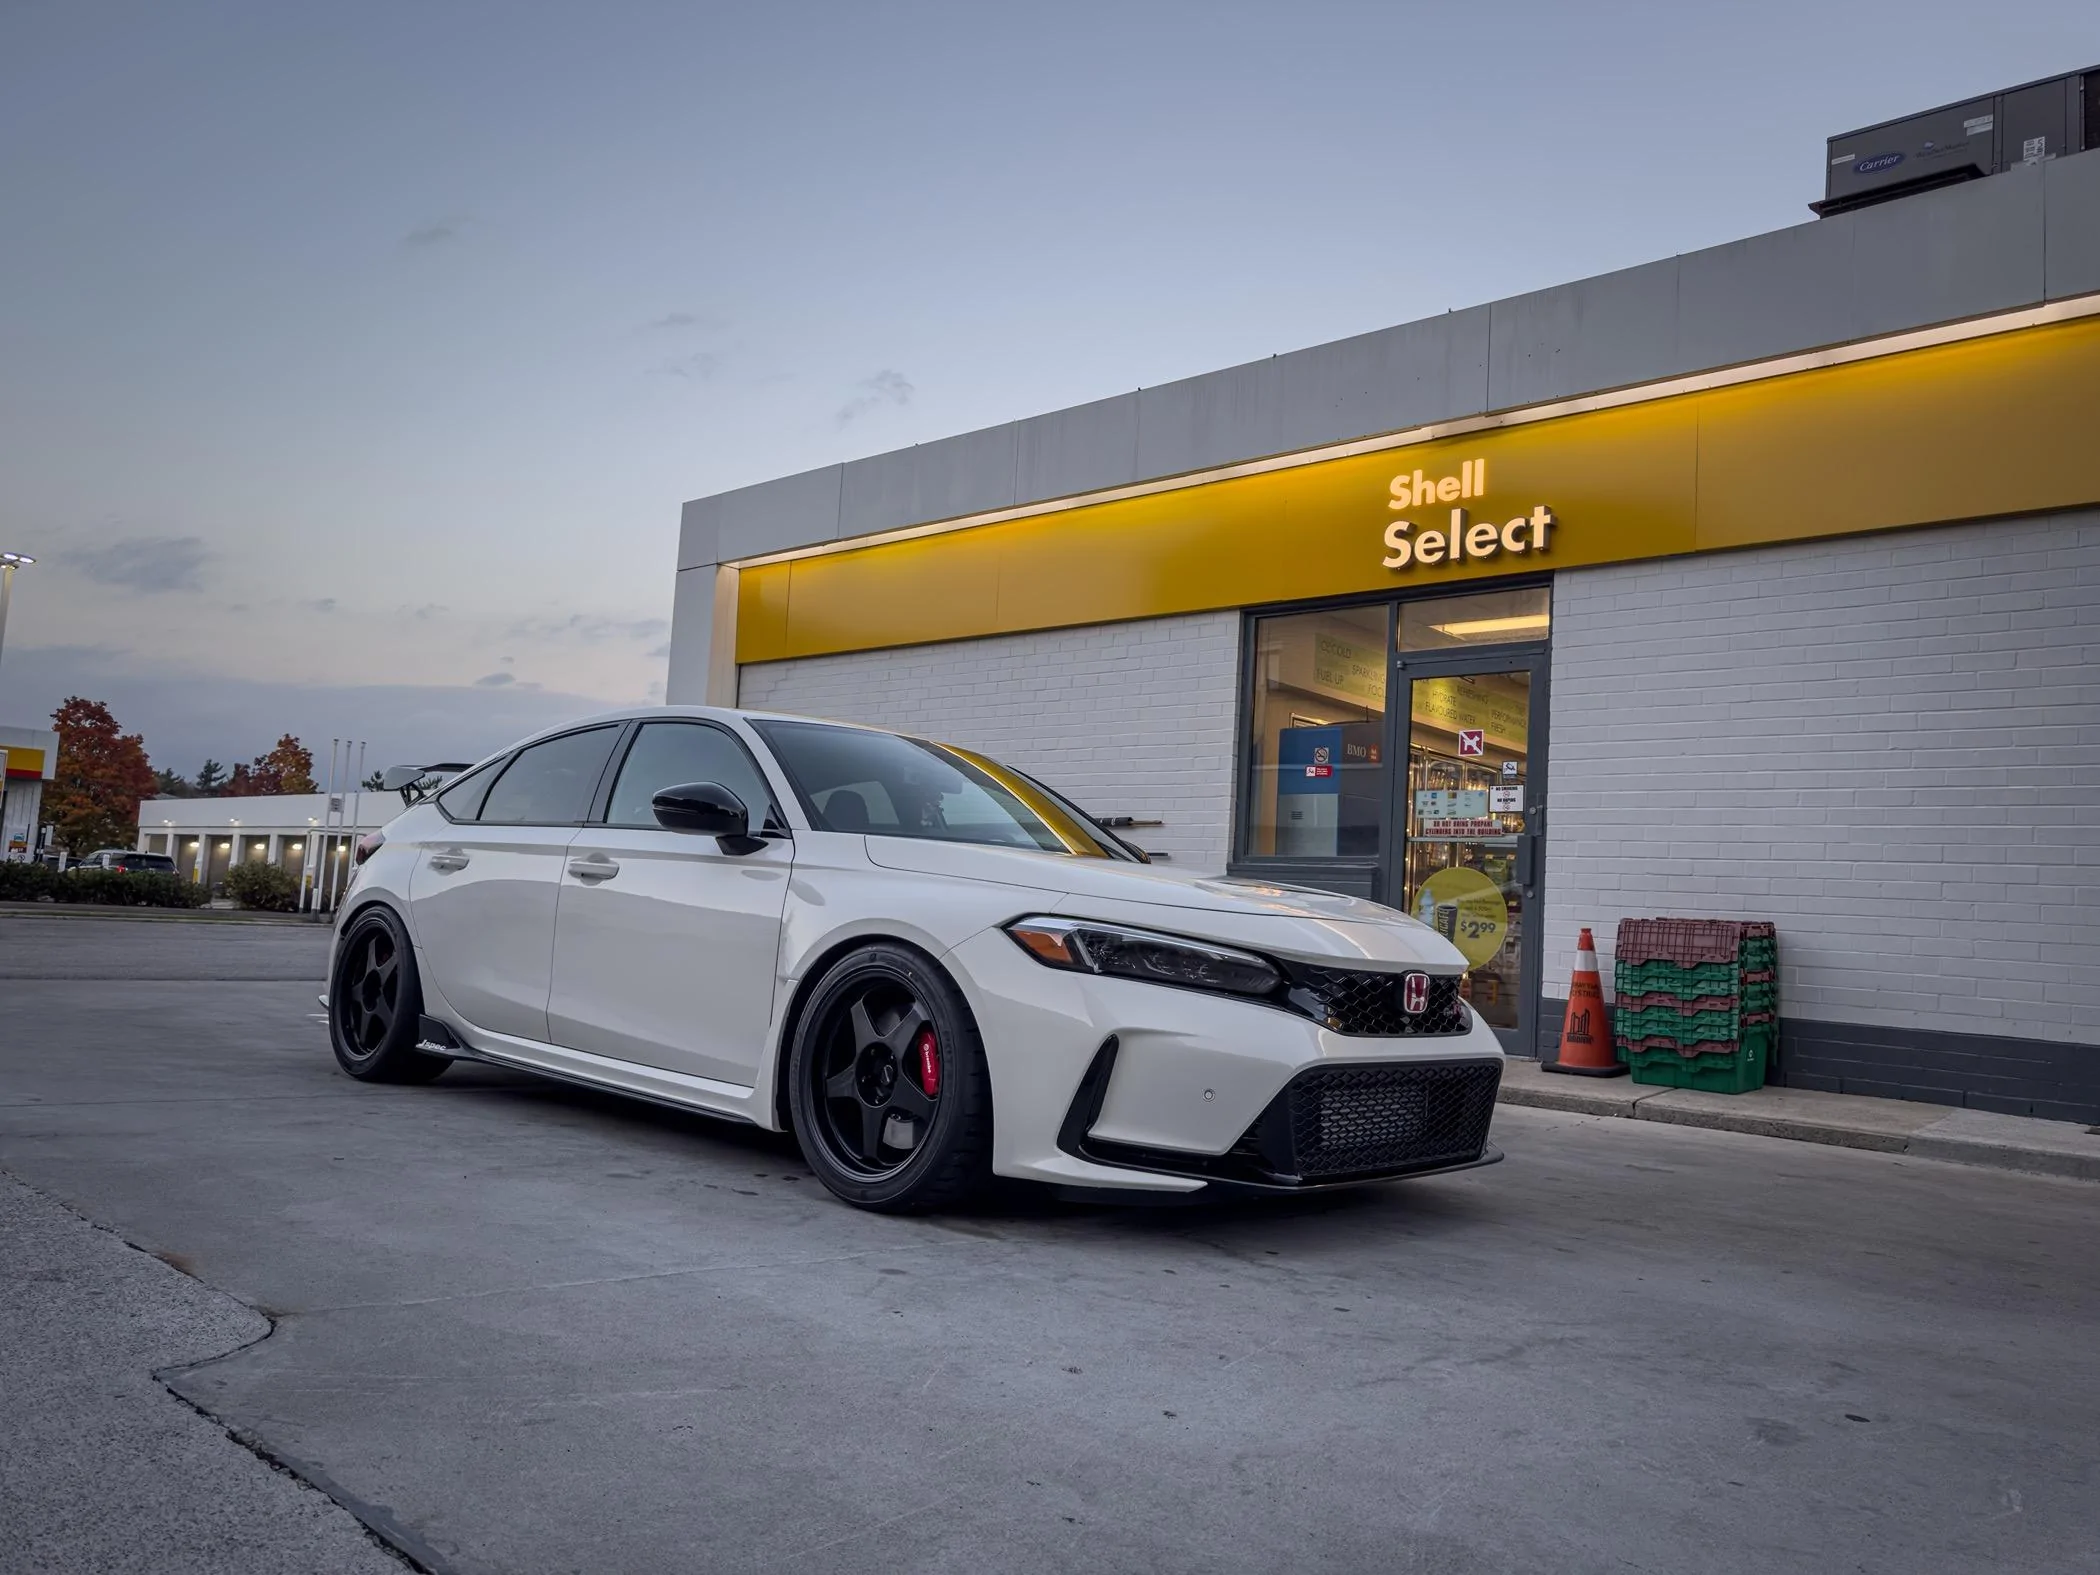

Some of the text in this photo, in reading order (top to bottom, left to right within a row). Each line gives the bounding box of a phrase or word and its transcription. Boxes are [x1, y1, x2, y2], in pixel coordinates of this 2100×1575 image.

[1859, 154, 1899, 172] Carrier
[1388, 458, 1485, 509] Shell
[1382, 505, 1552, 568] Select
[1316, 667, 1344, 685] FUEL UP
[1432, 689, 1457, 707] HYDRATE
[1425, 701, 1476, 725] FLAVOURED WATER
[1347, 743, 1367, 758] BMO
